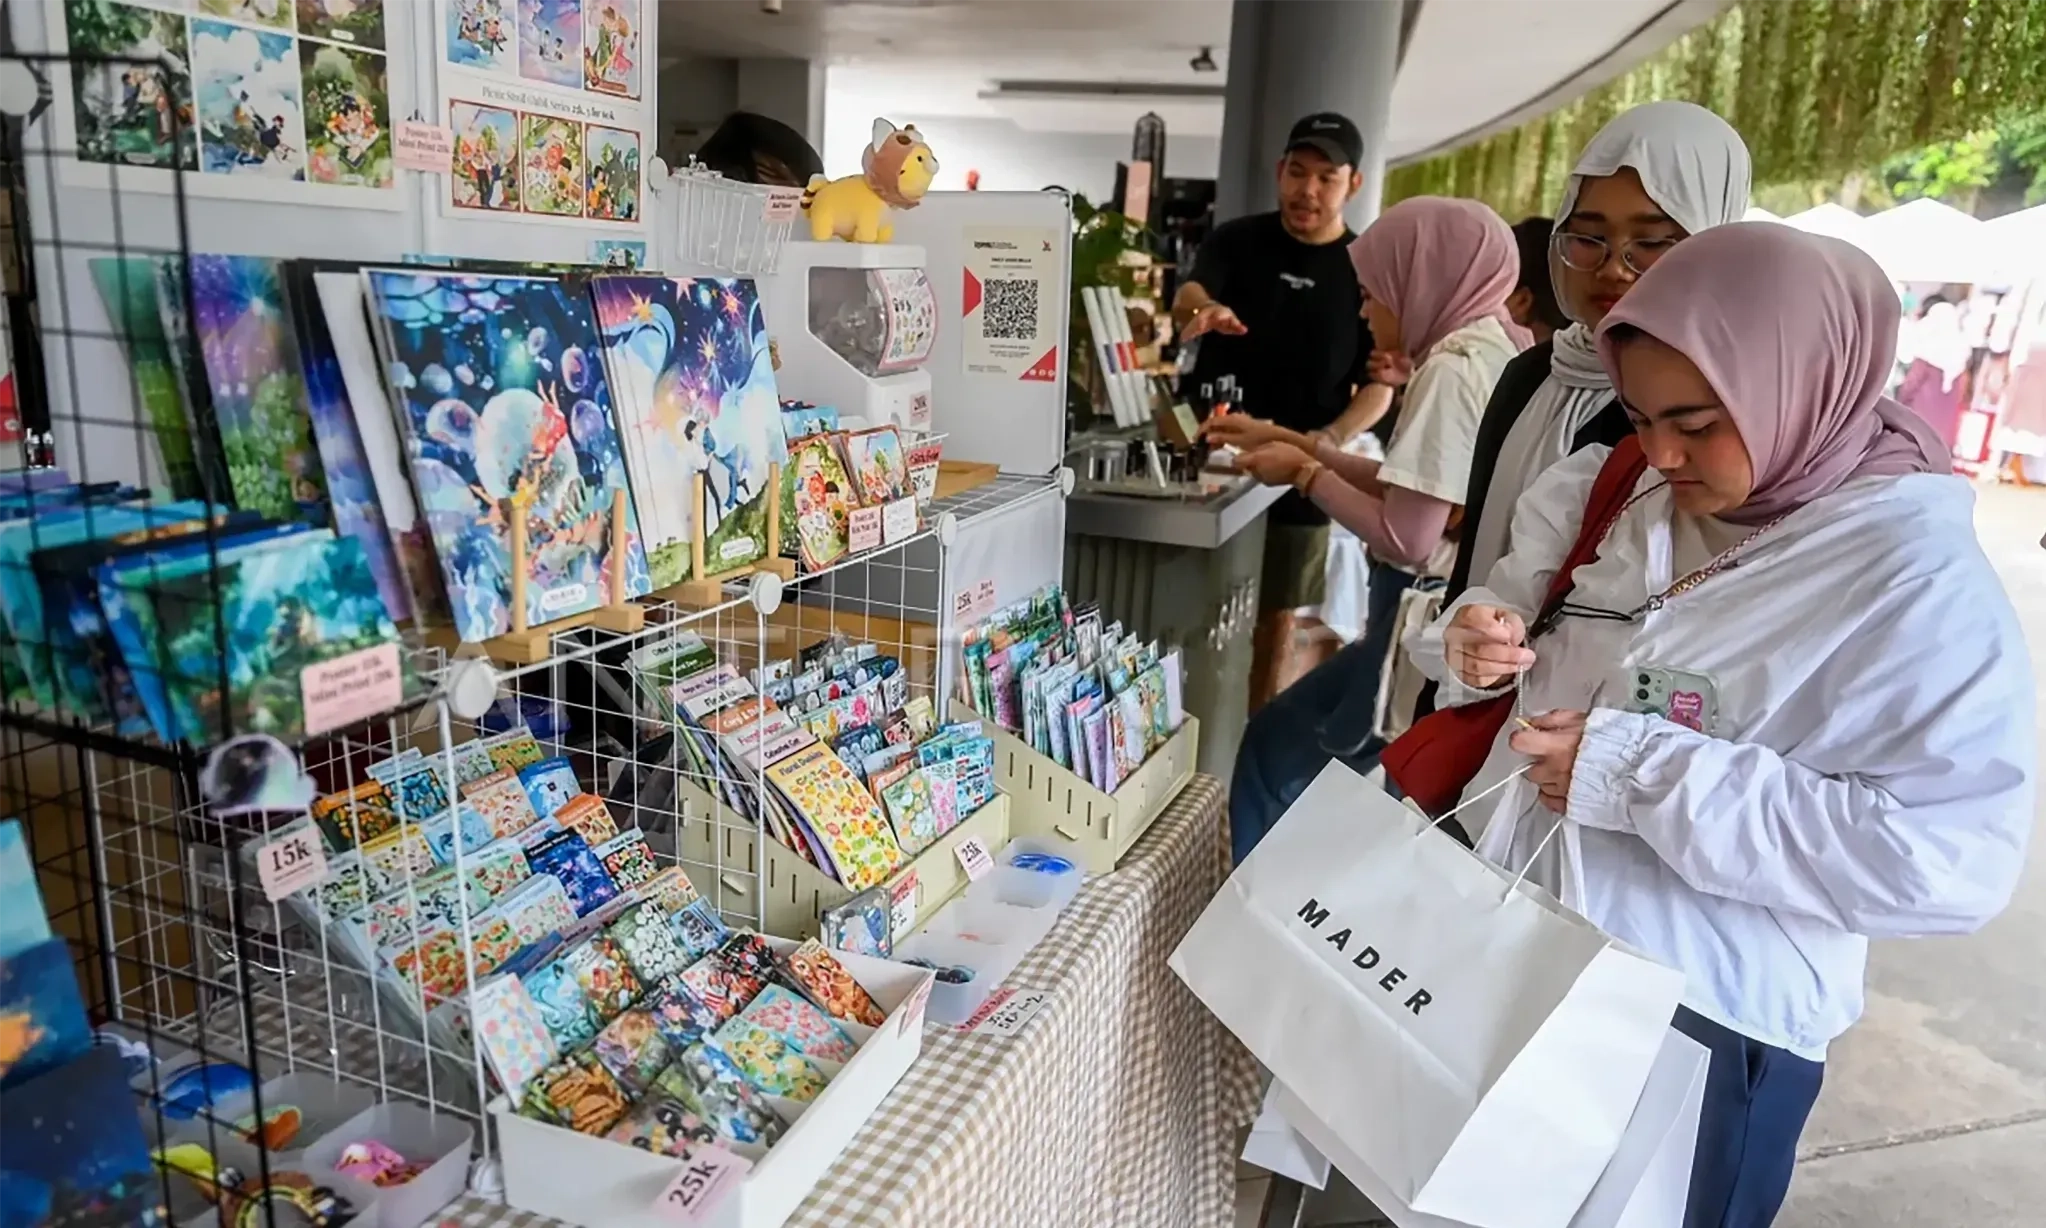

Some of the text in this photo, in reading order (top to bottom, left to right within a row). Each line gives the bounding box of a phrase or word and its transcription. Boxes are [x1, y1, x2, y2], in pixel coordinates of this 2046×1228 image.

[778, 760, 799, 776] Floral
[272, 838, 311, 872] 15k
[962, 840, 982, 862] 25k
[1297, 898, 1433, 1016] MADER
[668, 1160, 719, 1207] 25k
